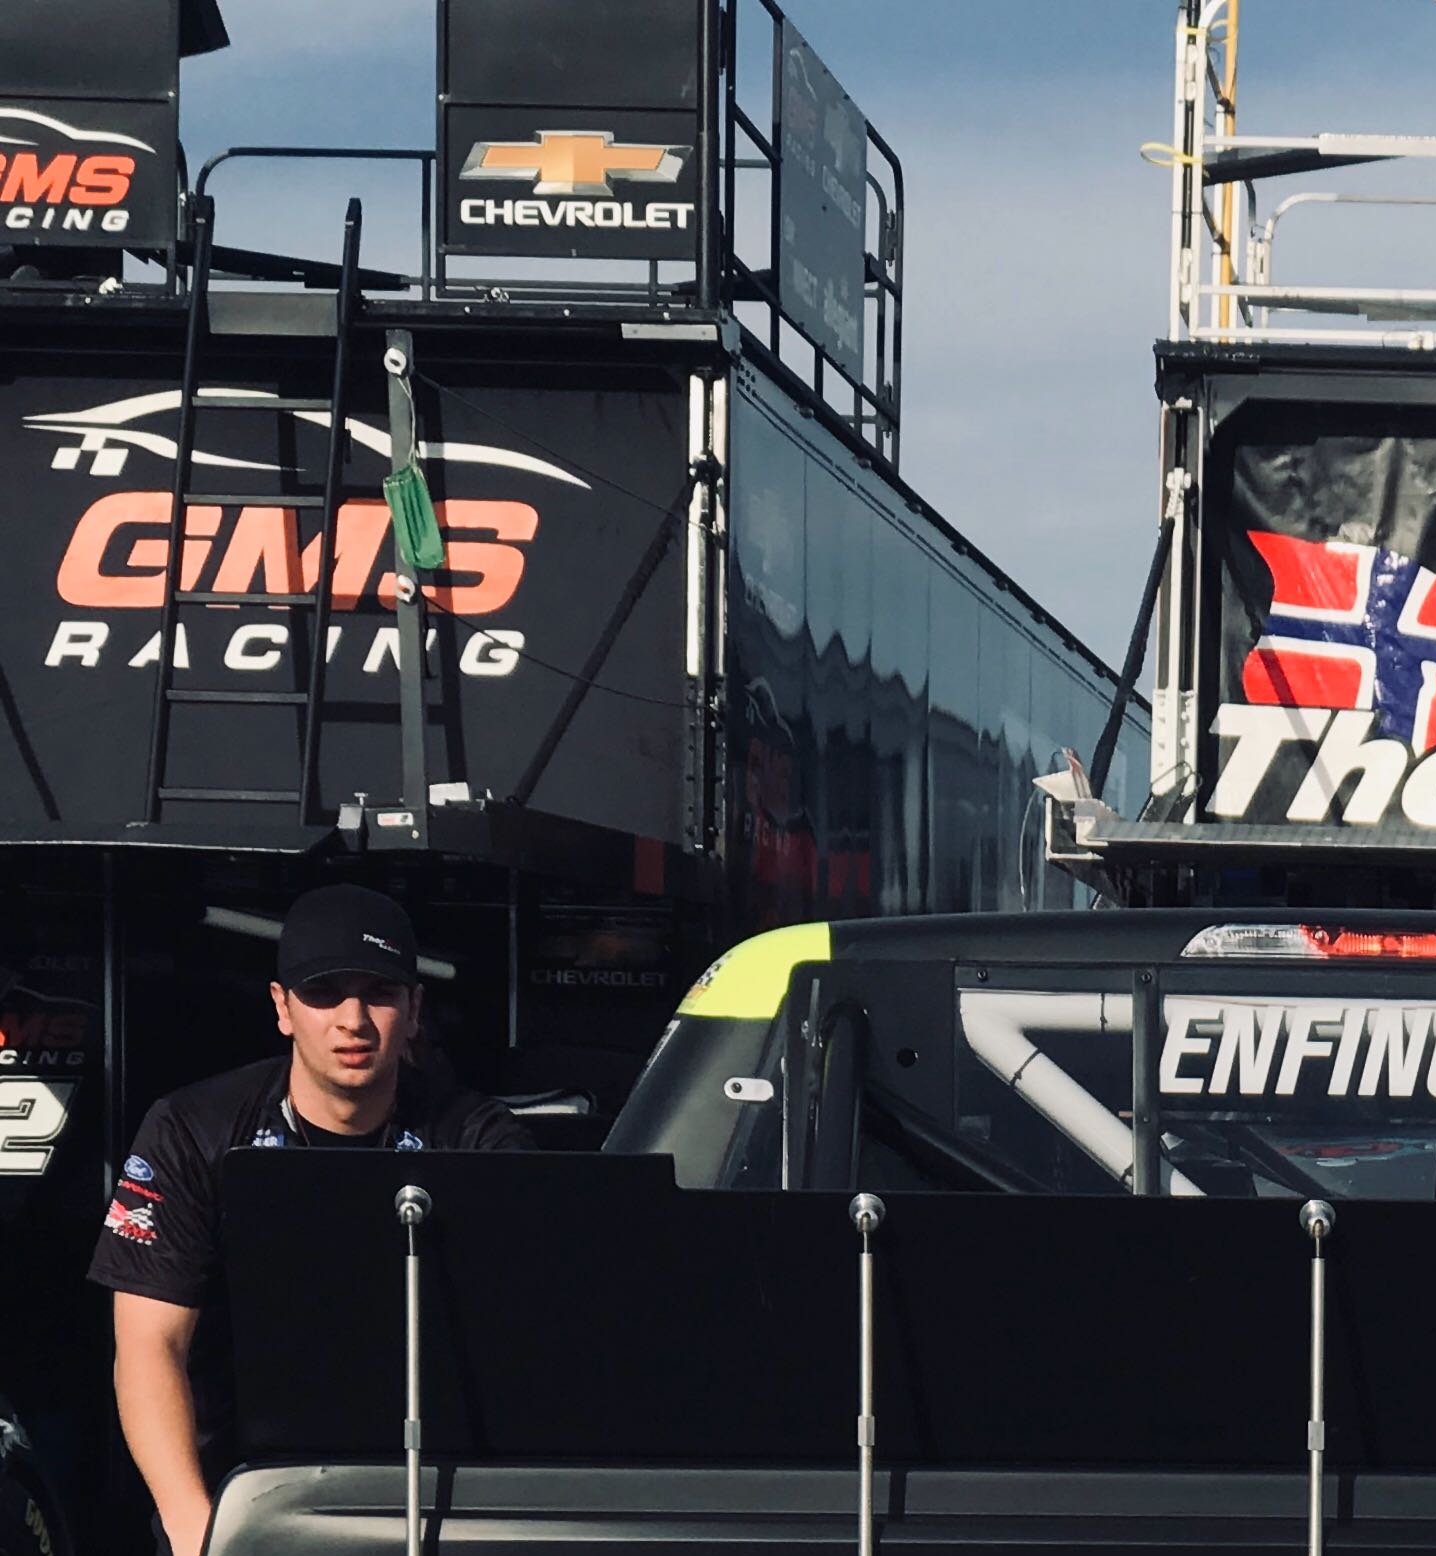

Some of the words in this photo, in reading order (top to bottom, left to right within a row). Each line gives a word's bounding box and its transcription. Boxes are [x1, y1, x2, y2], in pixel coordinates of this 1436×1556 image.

[0, 153, 136, 206] MS
[460, 197, 695, 230] CHEVROLET
[56, 491, 539, 615] GMS
